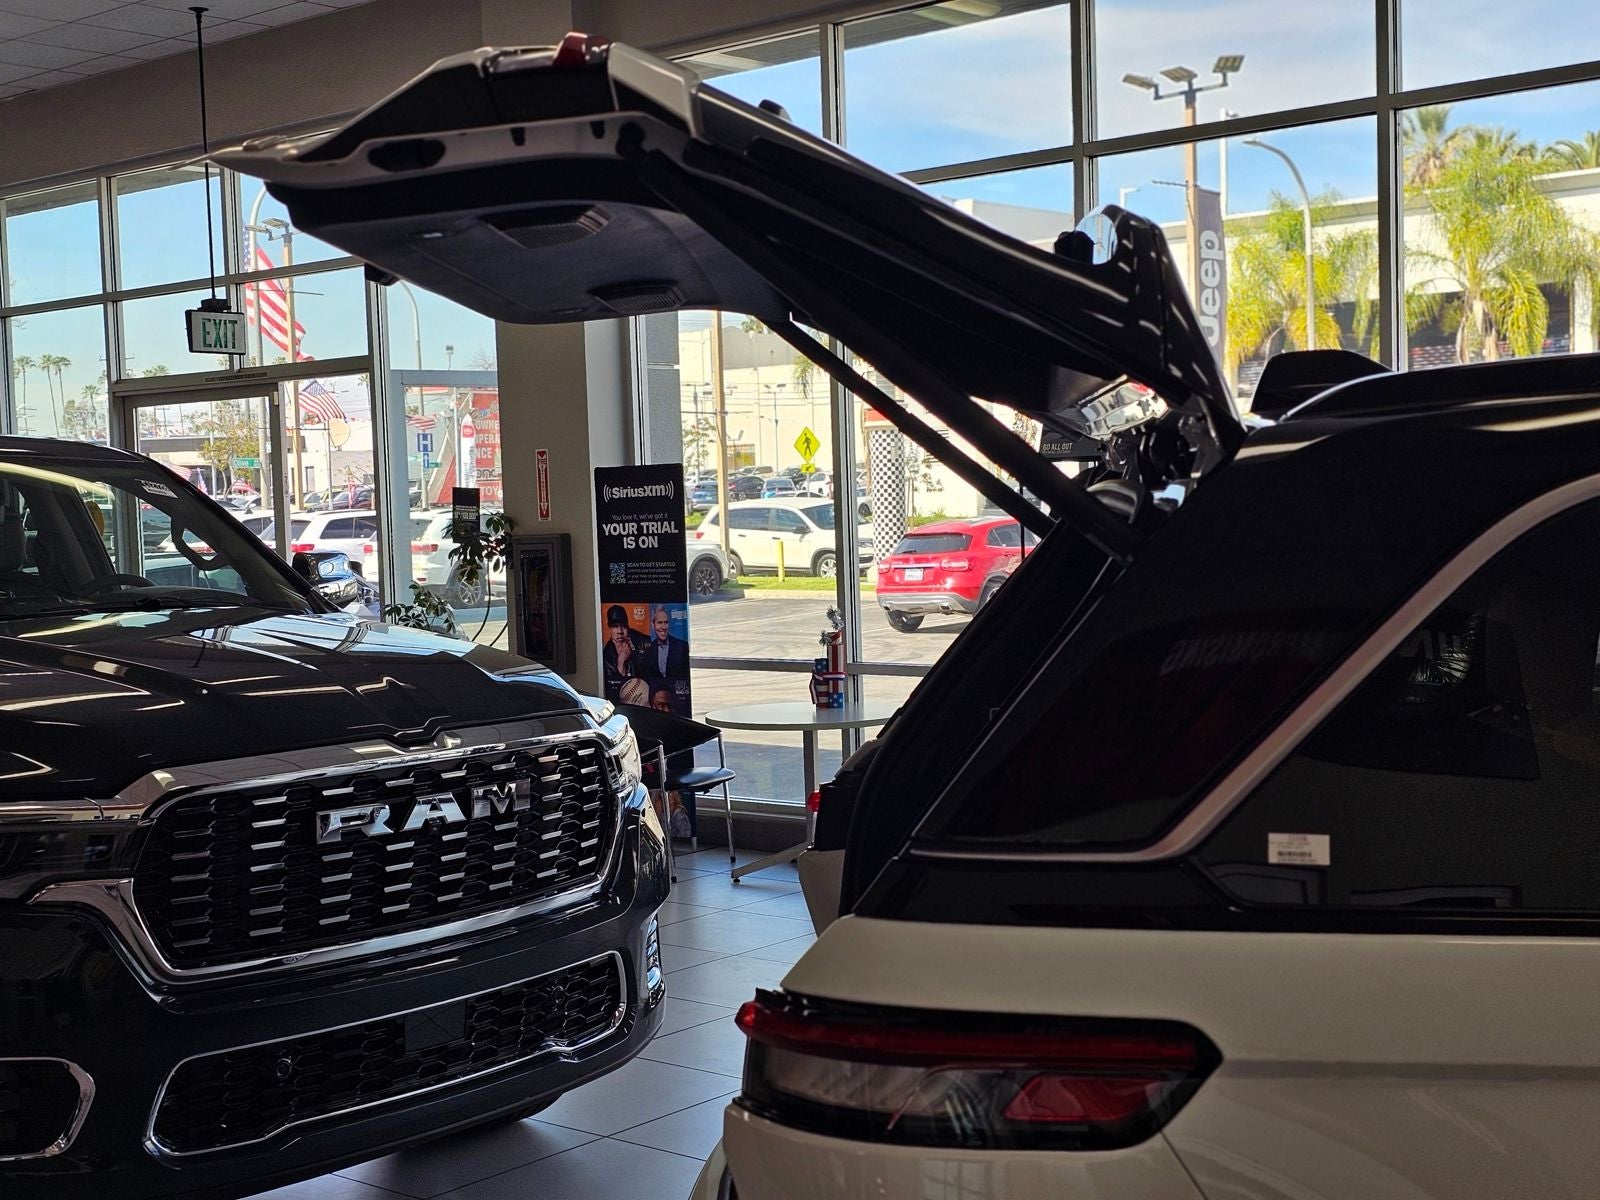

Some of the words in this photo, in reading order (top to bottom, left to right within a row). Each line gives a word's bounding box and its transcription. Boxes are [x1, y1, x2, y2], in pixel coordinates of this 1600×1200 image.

[1200, 230, 1224, 347] Jeep
[202, 318, 237, 349] EXIT
[1061, 442, 1072, 450] OUT
[233, 459, 249, 468] Olive
[639, 512, 654, 520] we've
[602, 522, 638, 536] YOUR
[640, 521, 679, 534] TRIAL
[623, 536, 636, 549] IS
[638, 536, 658, 548] ON
[316, 778, 531, 844] RAM
